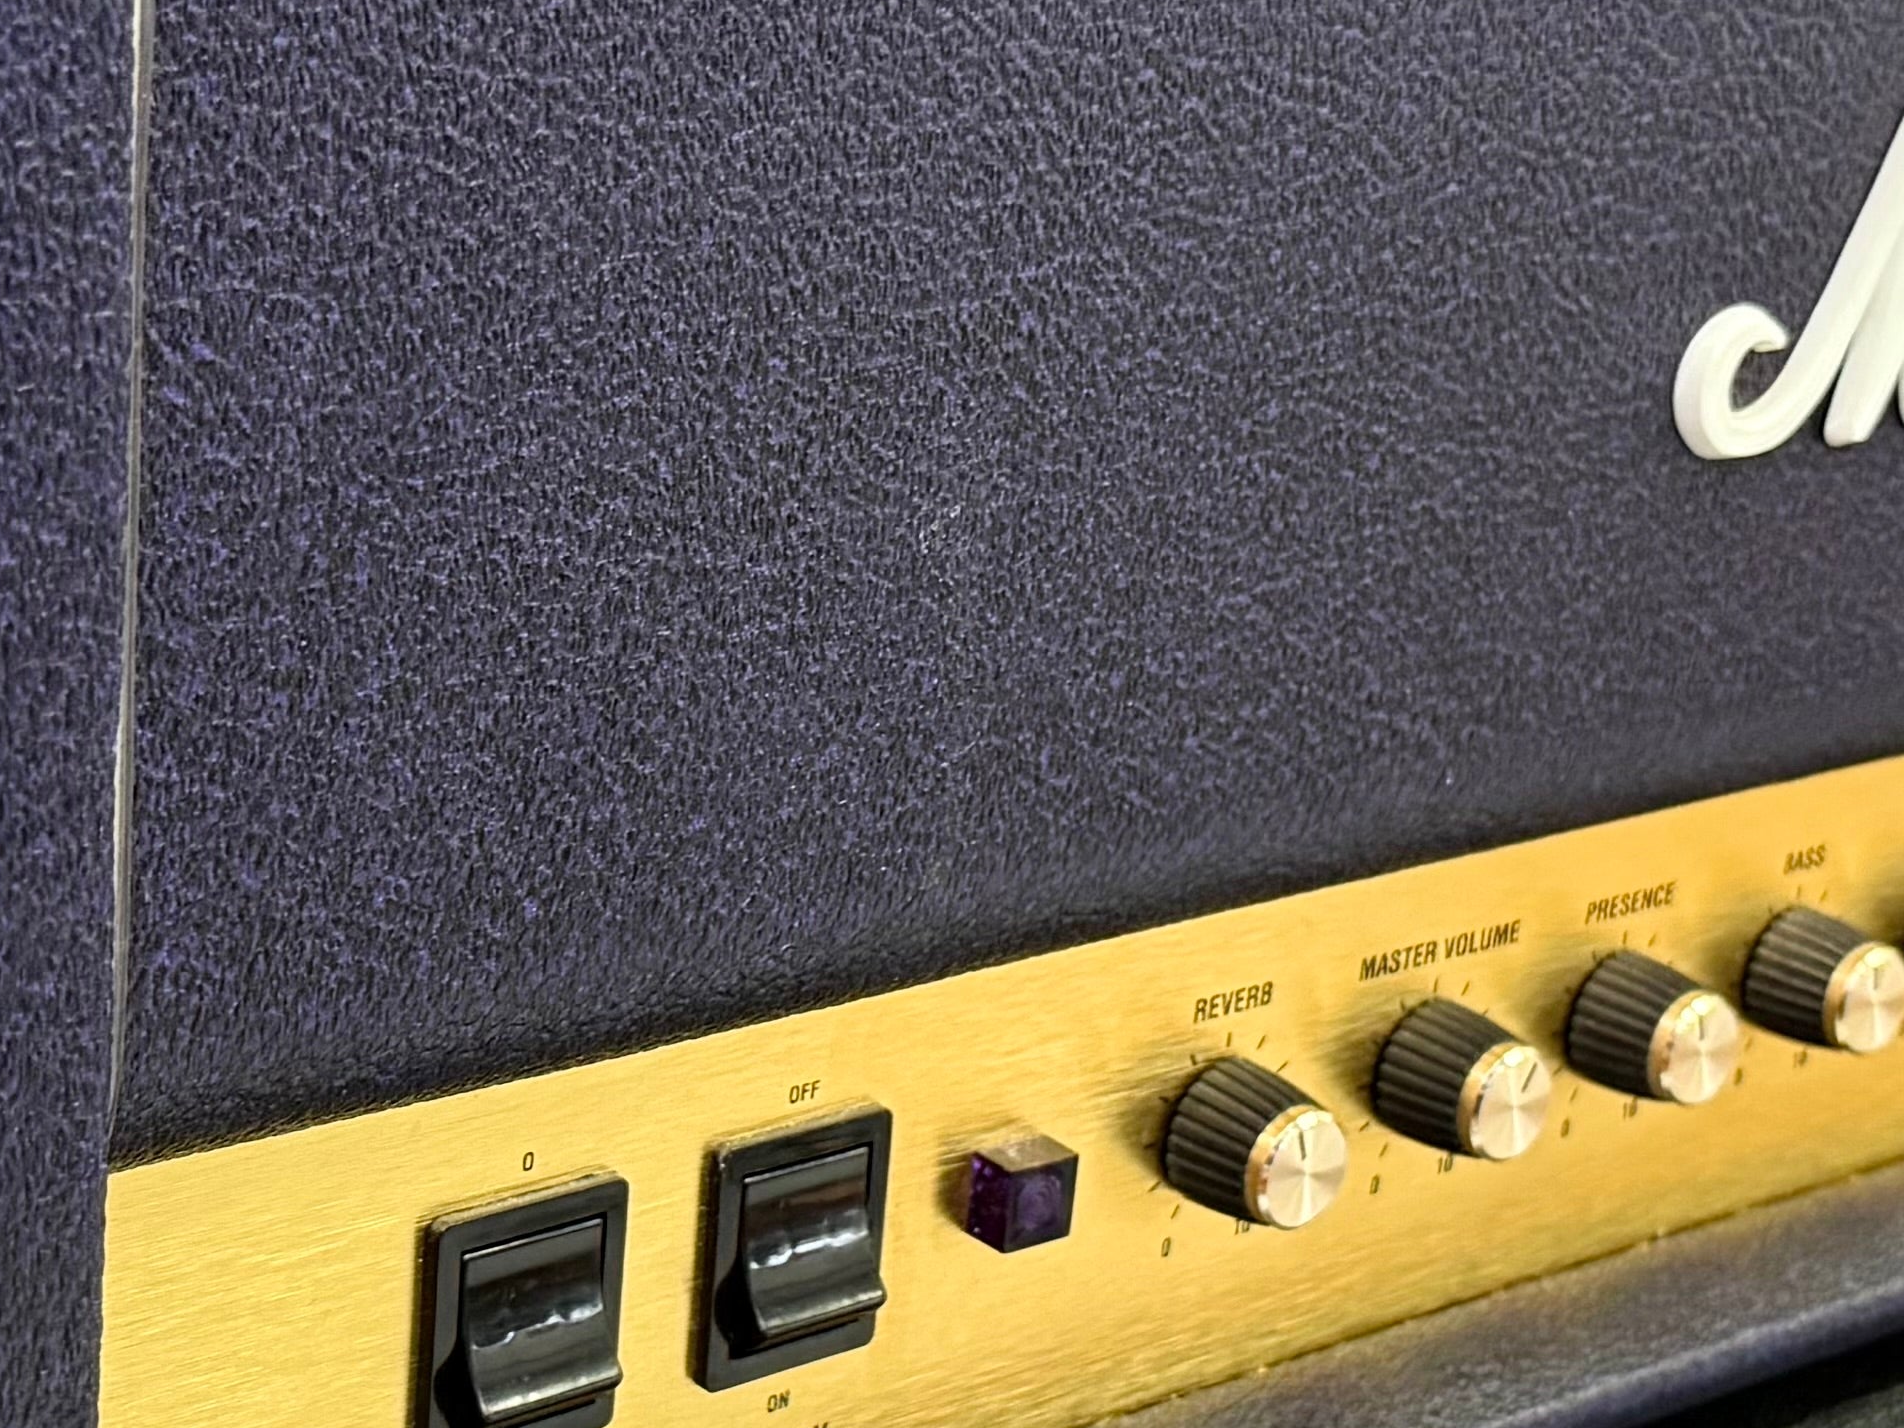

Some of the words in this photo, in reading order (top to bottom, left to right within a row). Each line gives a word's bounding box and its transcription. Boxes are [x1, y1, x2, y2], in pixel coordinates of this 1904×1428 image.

[1783, 843, 1827, 875] BASS
[1585, 880, 1678, 924] PRESENCE
[1359, 939, 1439, 981] MASTER
[1444, 919, 1520, 960] VOLUME
[1193, 981, 1274, 1024] REVERB
[789, 1079, 821, 1105] OFF
[766, 1389, 791, 1414] ON
